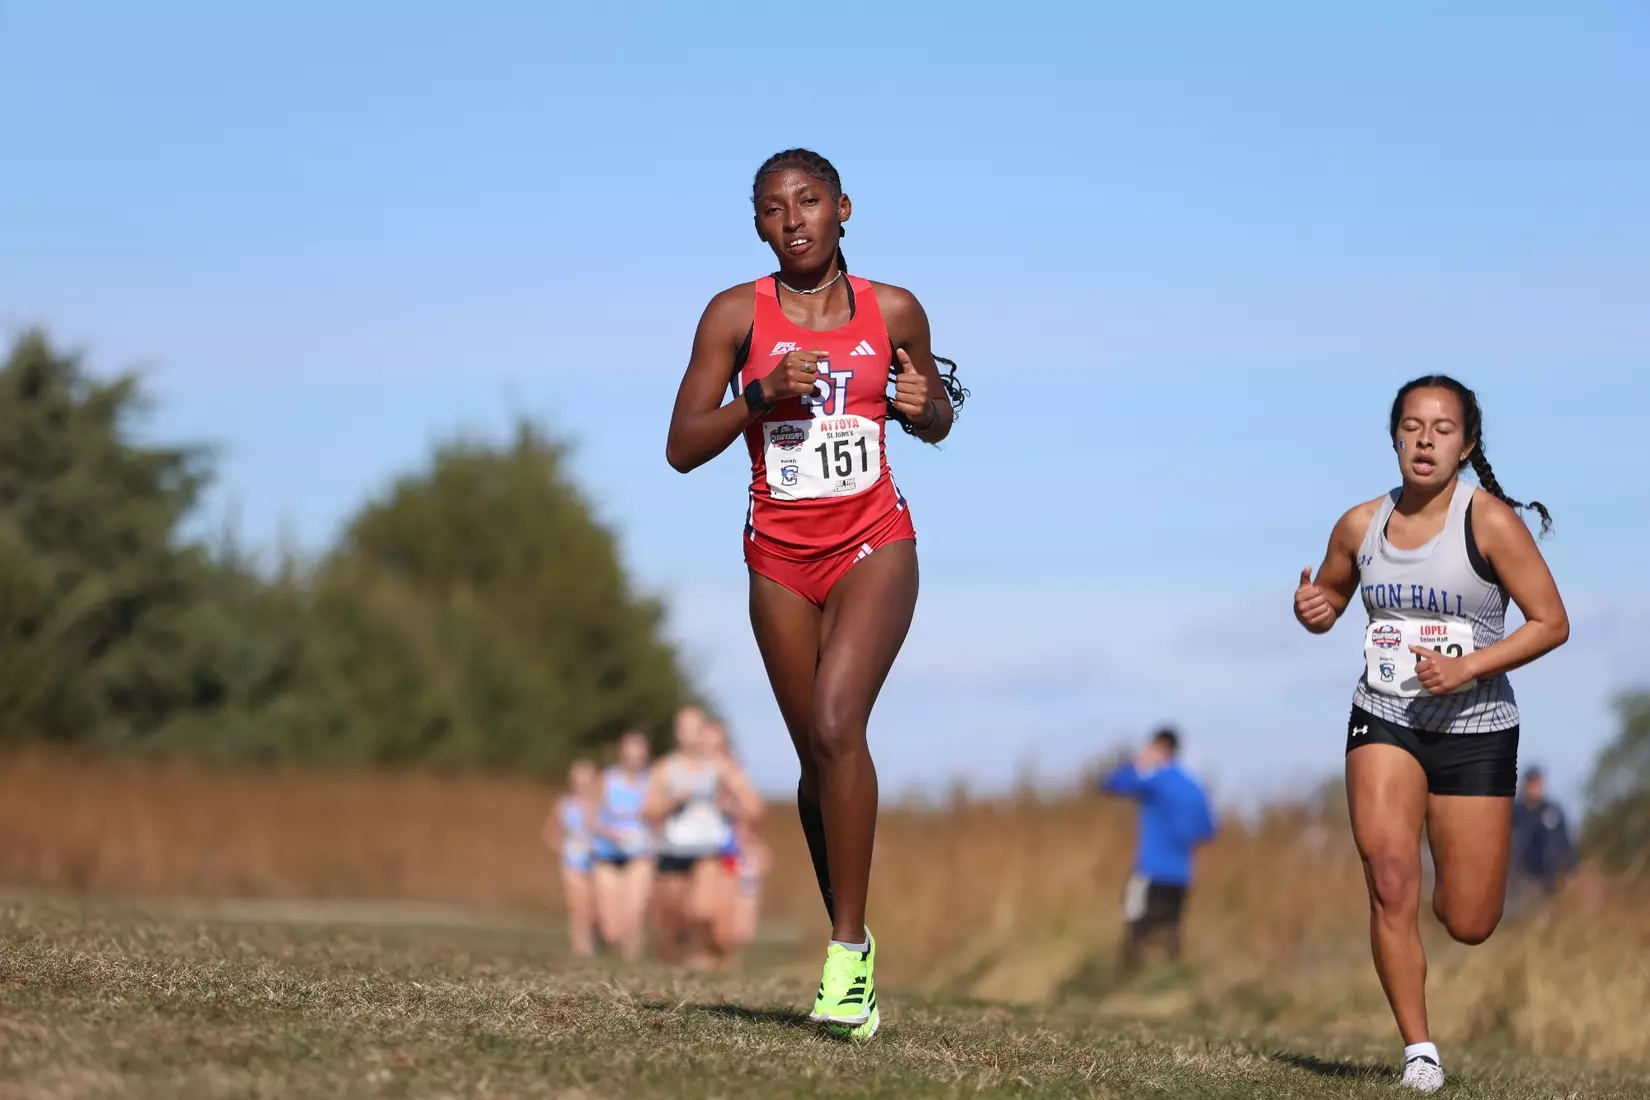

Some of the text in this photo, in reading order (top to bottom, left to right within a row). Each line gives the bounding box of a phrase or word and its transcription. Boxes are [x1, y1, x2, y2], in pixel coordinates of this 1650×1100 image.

[821, 418, 860, 431] ATTOYA
[836, 430, 854, 438] John's
[815, 436, 868, 479] 151
[1361, 584, 1467, 618] TON HALL
[1421, 625, 1448, 636] LOPEZ
